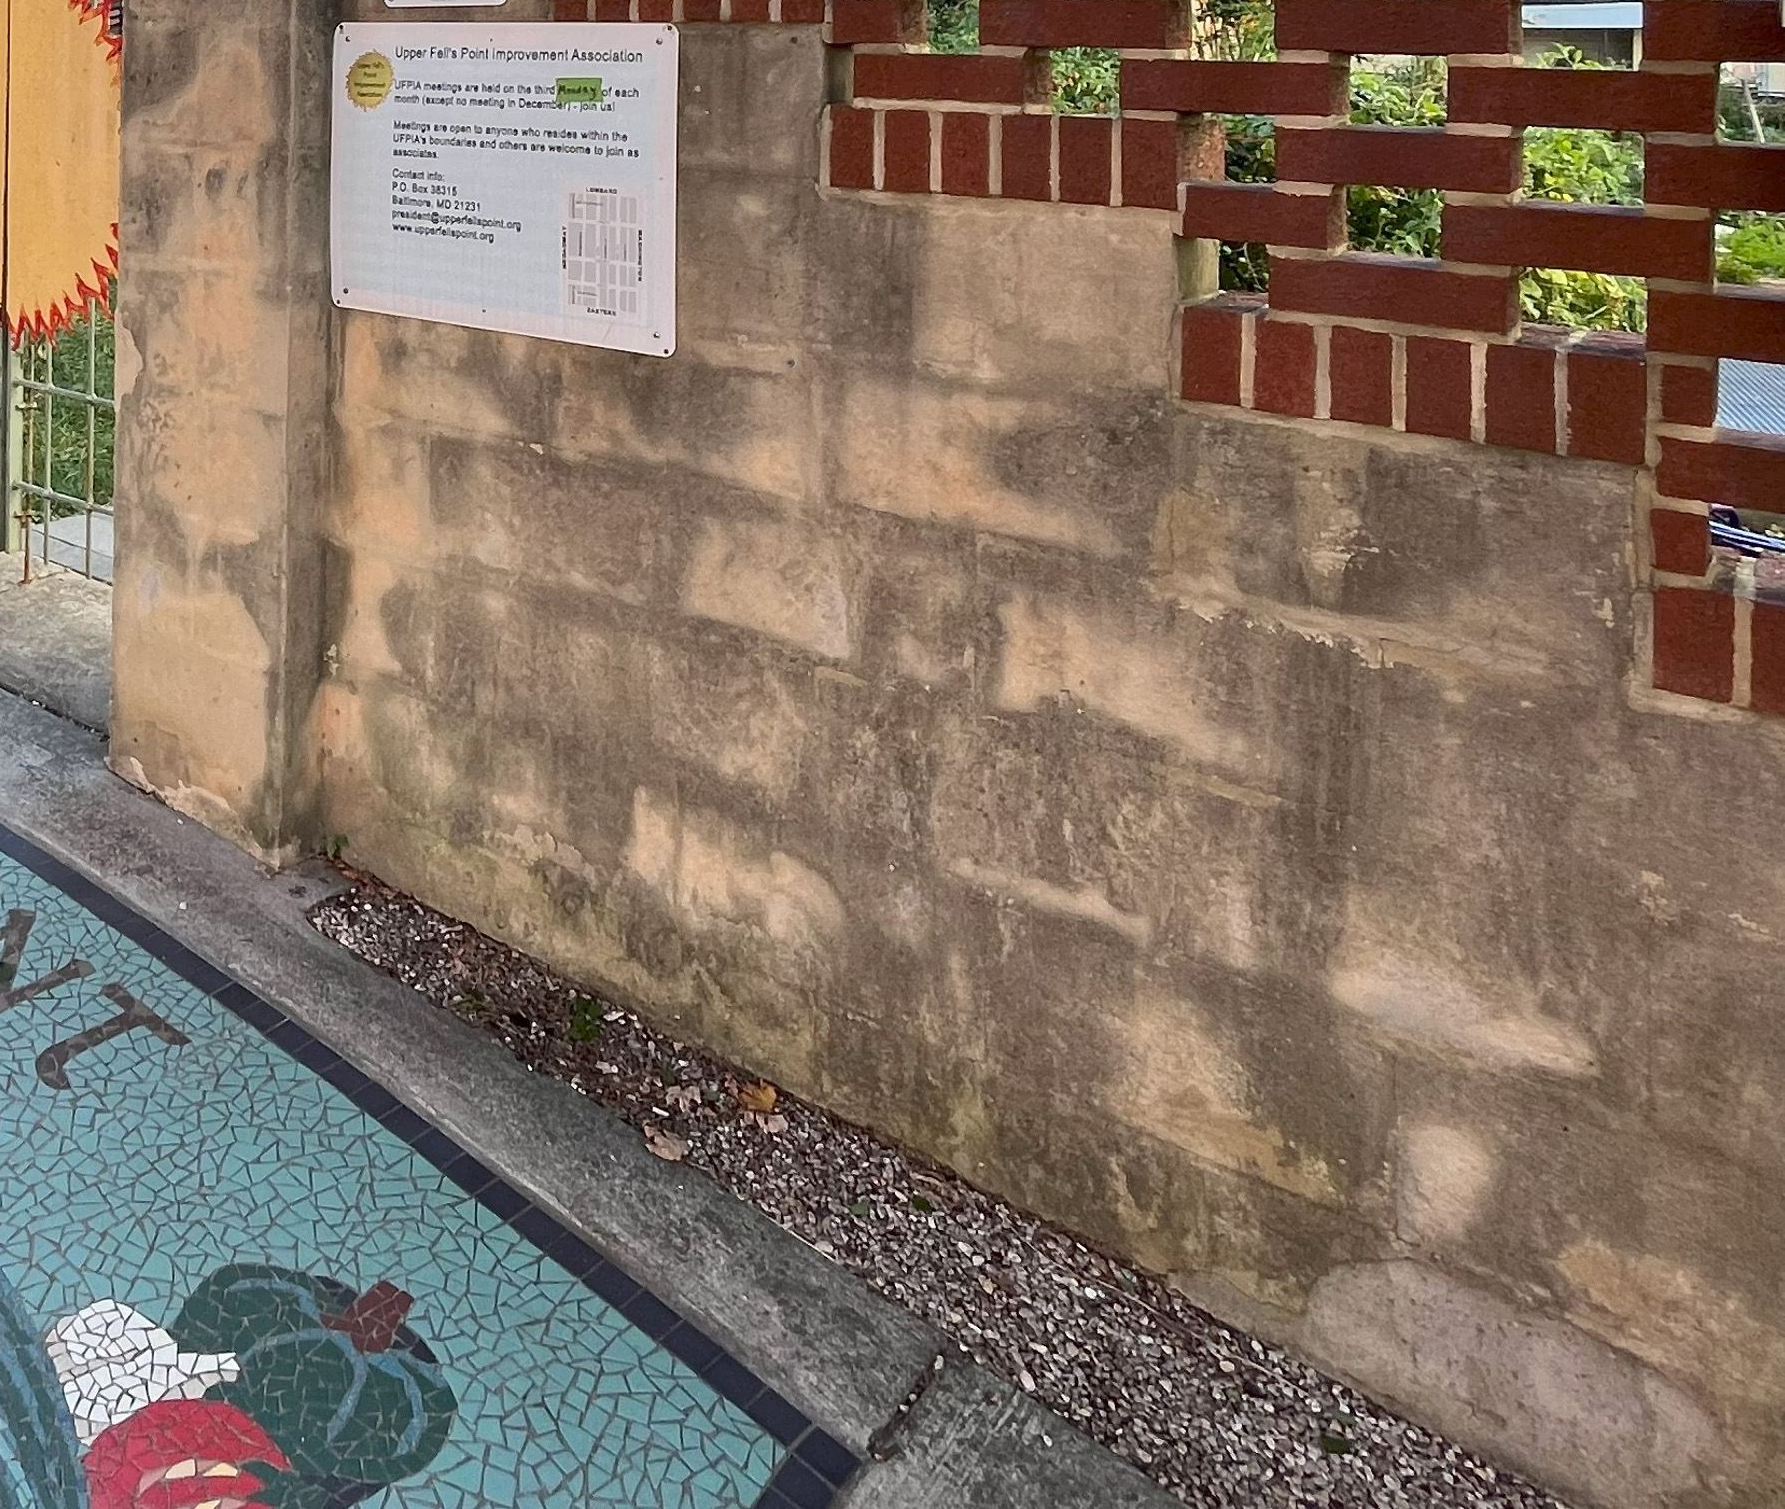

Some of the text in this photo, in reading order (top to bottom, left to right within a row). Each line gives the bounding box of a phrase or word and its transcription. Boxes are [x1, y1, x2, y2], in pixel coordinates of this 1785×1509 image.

[395, 46, 643, 62] Upper Fell's Point Improvement Association
[394, 80, 421, 90] UFPIA
[423, 82, 462, 93] meetings
[465, 84, 479, 92] are
[481, 83, 501, 93] held
[503, 85, 514, 93] on
[517, 84, 531, 94] the
[534, 84, 555, 95] third
[602, 86, 612, 97] of
[615, 87, 640, 98] each
[394, 94, 420, 103] month
[422, 95, 454, 106] (except
[456, 97, 467, 106] no
[469, 97, 505, 109] meeting
[507, 98, 516, 107] in
[518, 98, 571, 111] December)
[579, 101, 597, 113] join
[601, 102, 615, 112] us!
[393, 120, 628, 142] Meetings are open to anyone who resides within the
[429, 136, 476, 147] boundaries
[479, 139, 496, 149] and
[499, 141, 527, 151] others
[530, 143, 545, 151] are
[548, 143, 591, 154] welcome
[594, 146, 603, 155] to
[606, 146, 624, 158] join
[627, 149, 640, 158] as
[392, 168, 445, 182] Contact info:
[412, 183, 428, 194] Box
[392, 195, 481, 212] Baltimore, MD 21231
[392, 210, 521, 232] president@upperfellspoint.org
[392, 223, 494, 243] www.upperfellspoint.org
